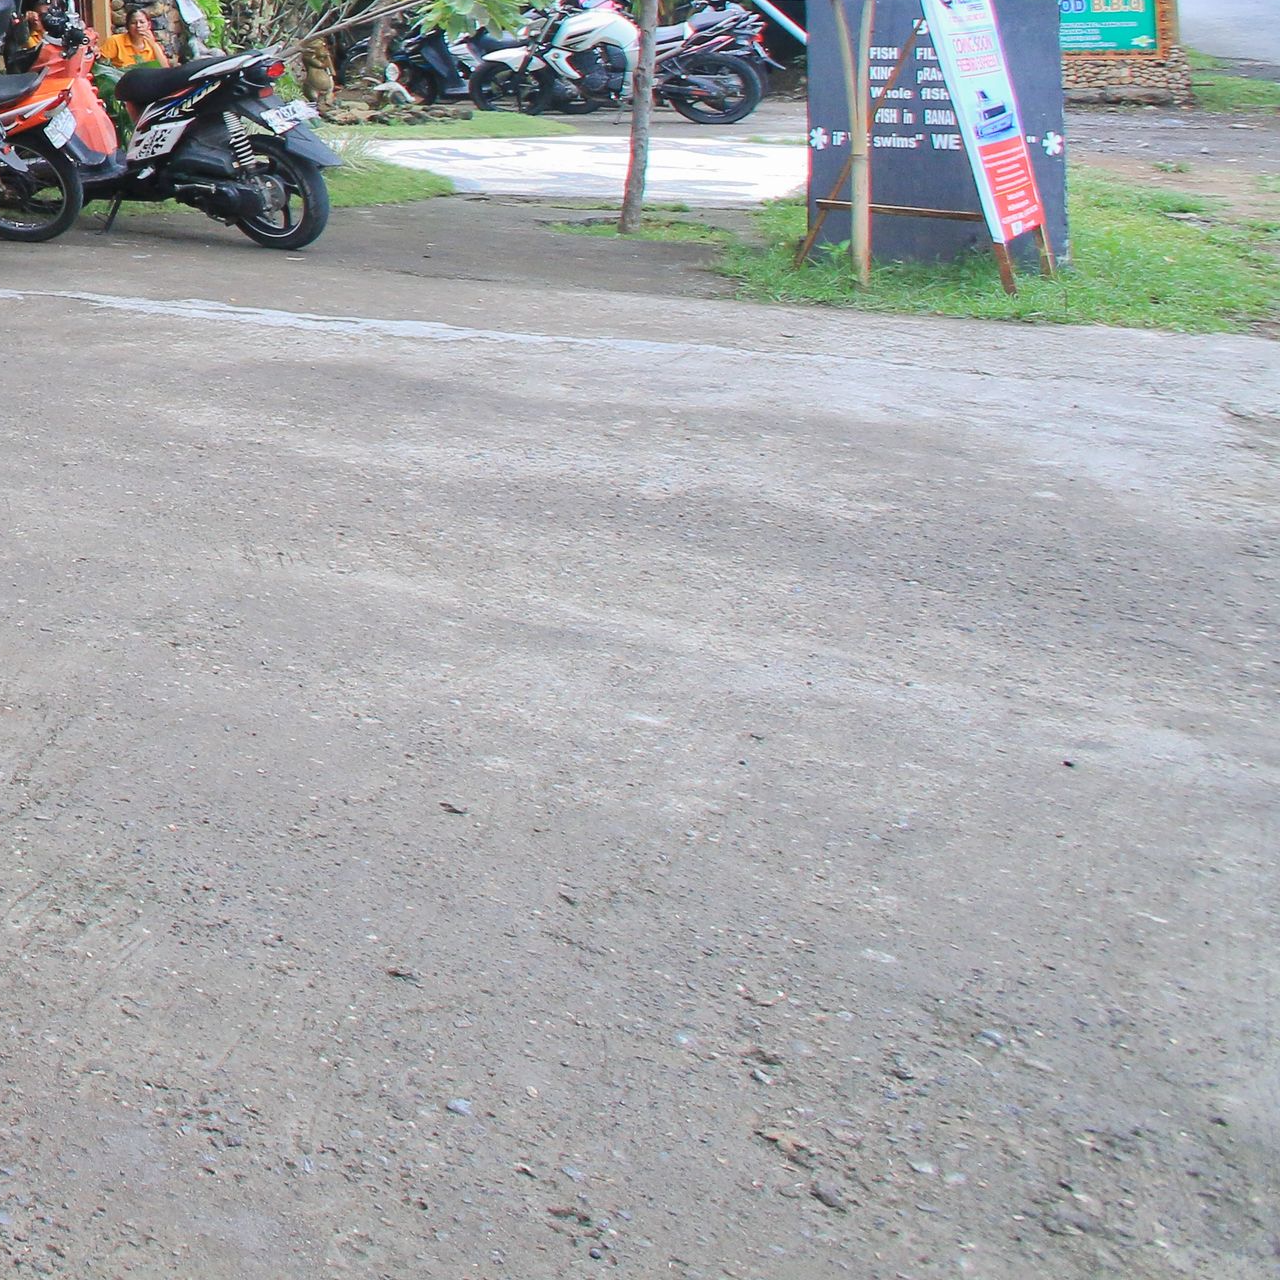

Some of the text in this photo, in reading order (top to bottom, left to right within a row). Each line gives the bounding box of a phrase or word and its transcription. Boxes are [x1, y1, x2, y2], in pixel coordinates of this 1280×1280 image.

[869, 47, 898, 60] FISH
[875, 109, 897, 124] FISH
[903, 110, 913, 124] in
[931, 134, 961, 150] WE
